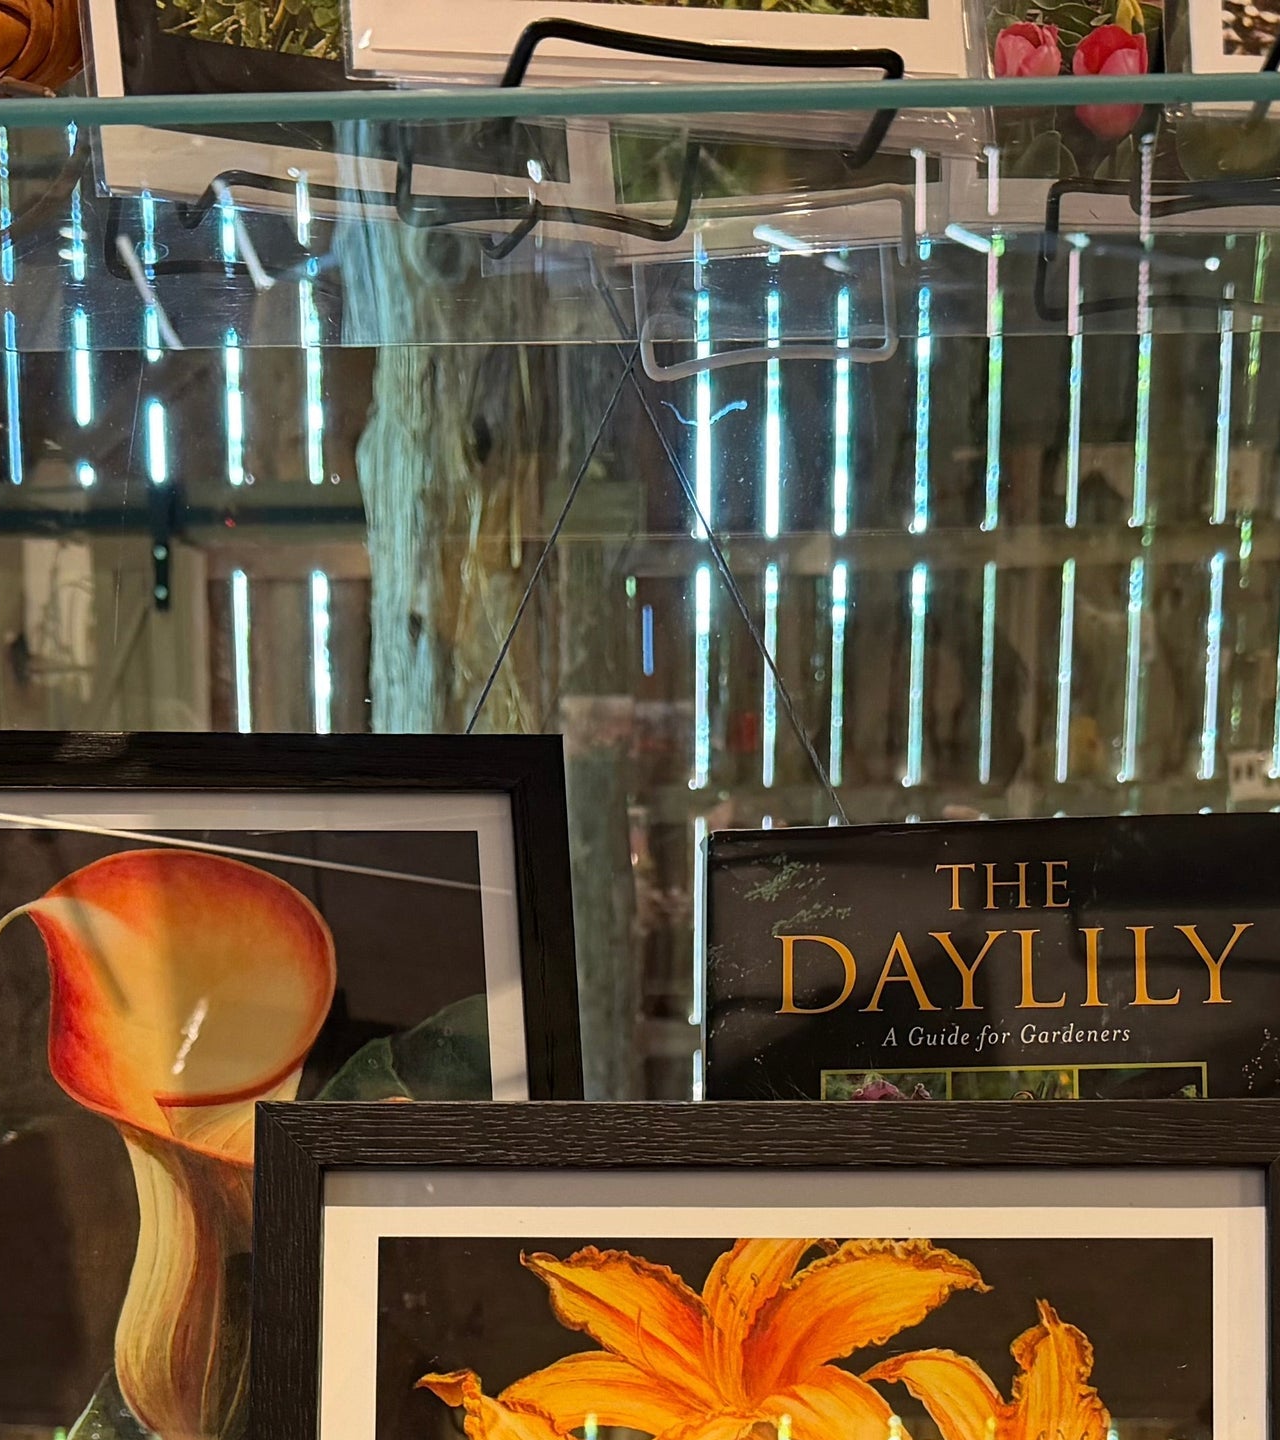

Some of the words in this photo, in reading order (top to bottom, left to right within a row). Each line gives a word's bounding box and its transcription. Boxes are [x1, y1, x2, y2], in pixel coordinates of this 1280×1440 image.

[934, 860, 1071, 911] THE
[774, 922, 1255, 1015] DAYLILY
[881, 1026, 898, 1047] A
[908, 1025, 971, 1047] Guide
[974, 1024, 1011, 1052] for
[1020, 1023, 1131, 1045] Gardeners
